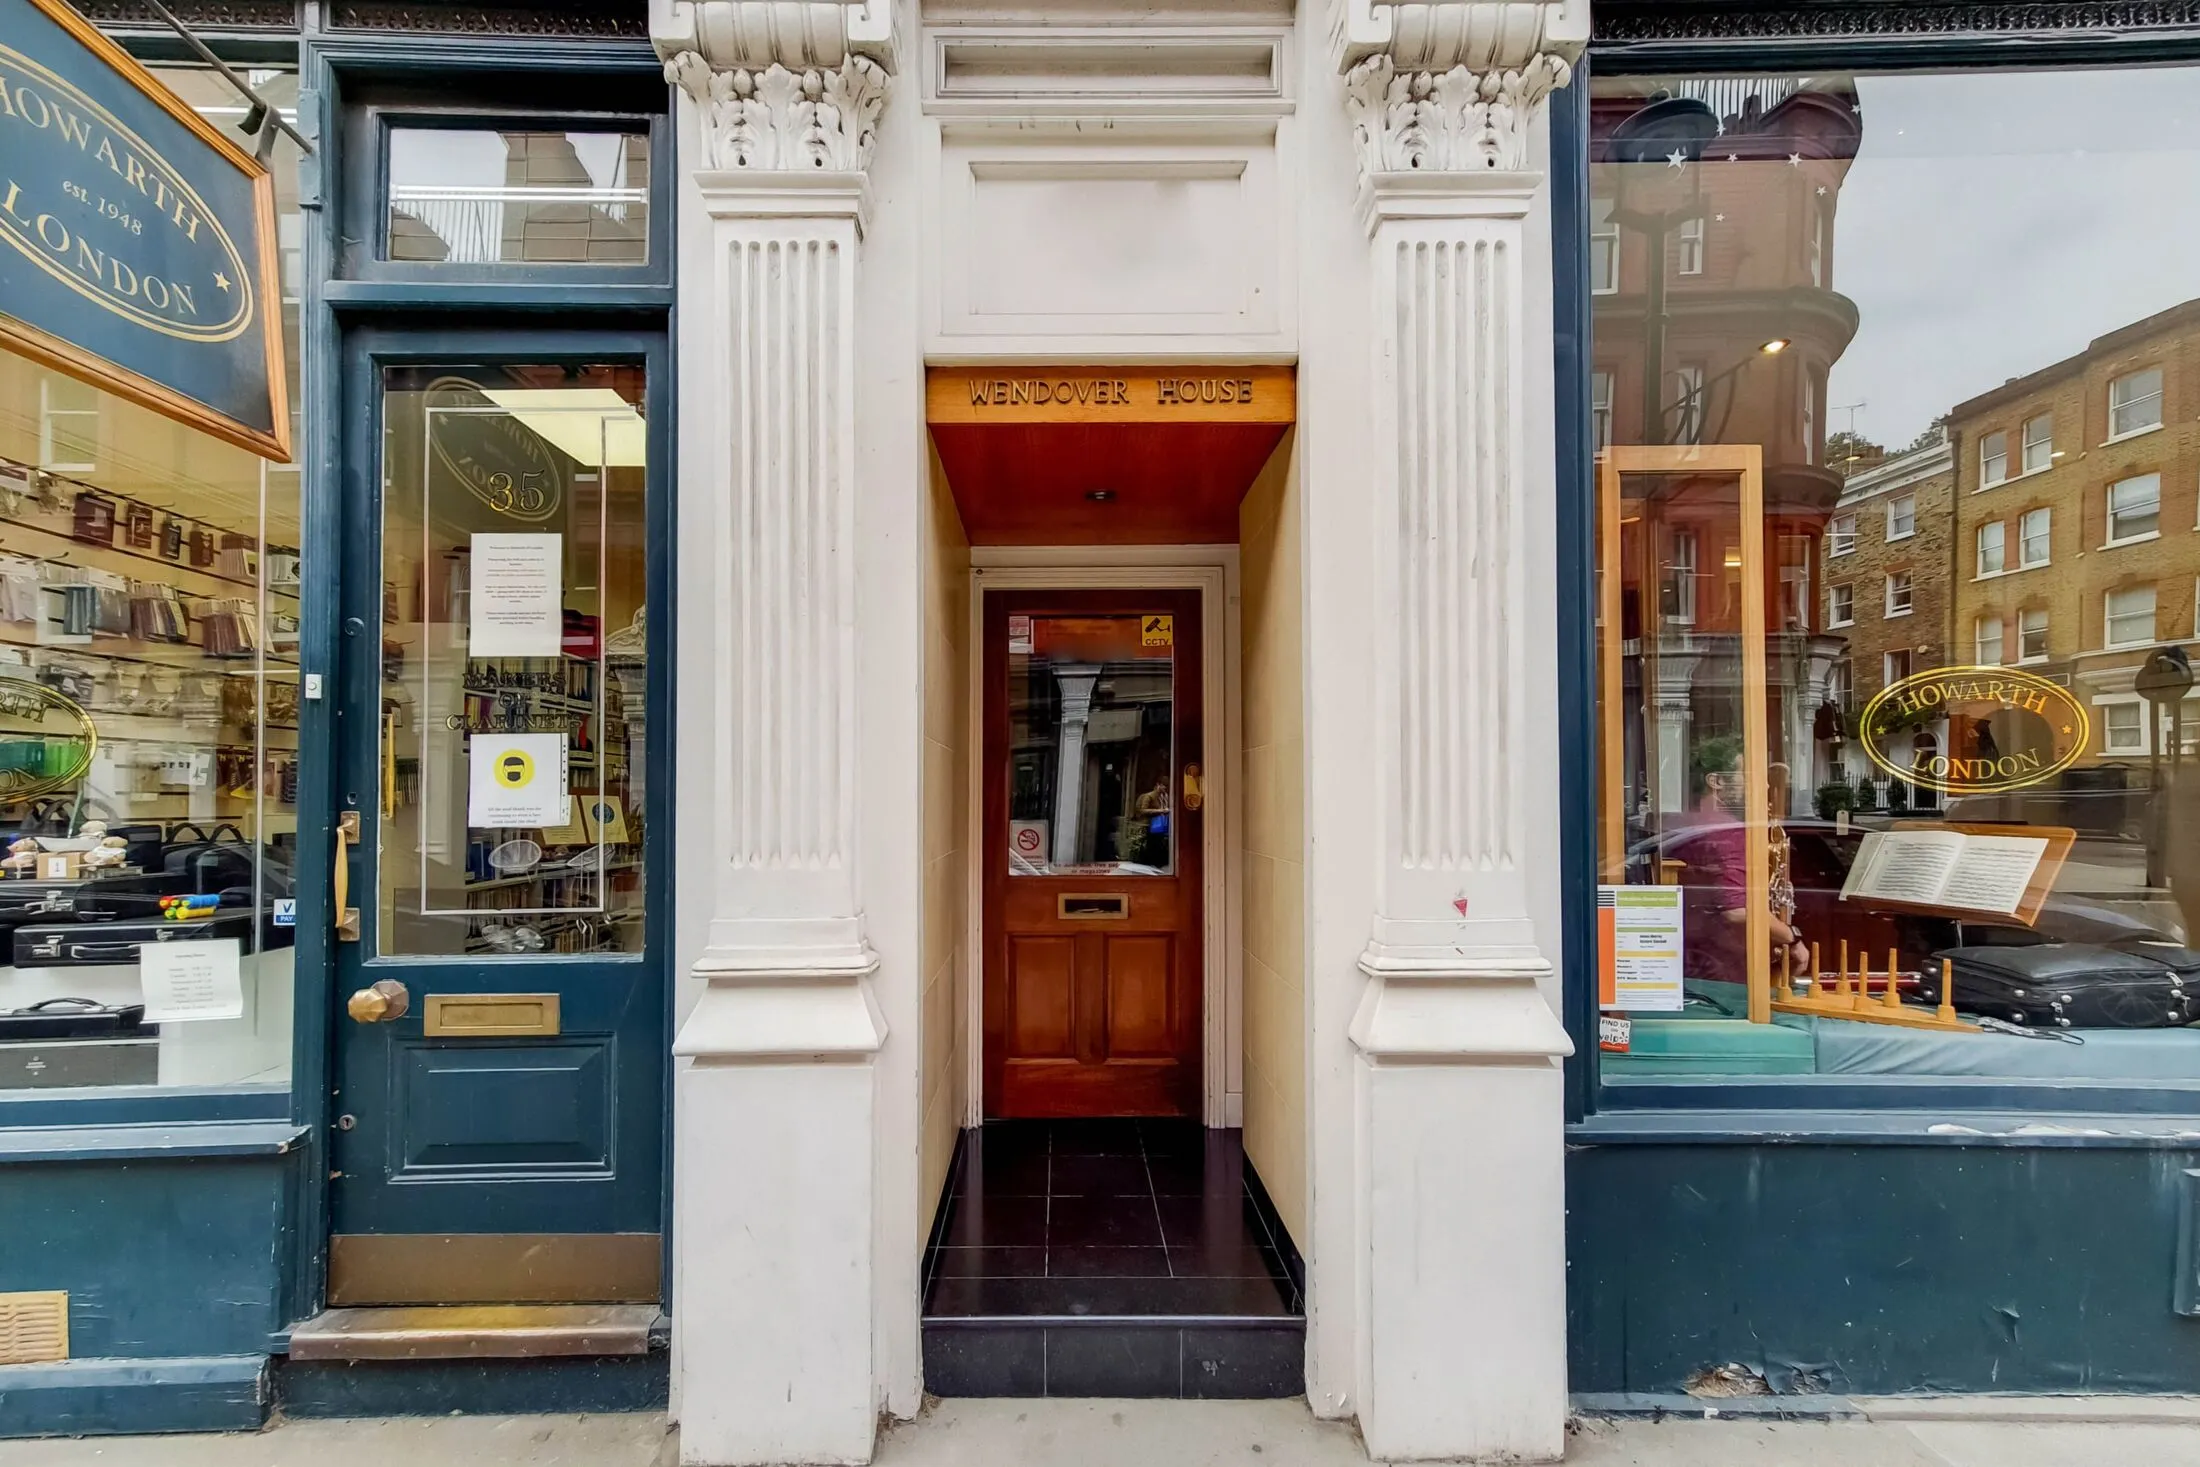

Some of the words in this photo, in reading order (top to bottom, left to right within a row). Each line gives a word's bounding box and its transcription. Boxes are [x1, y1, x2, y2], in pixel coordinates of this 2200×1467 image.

[62, 180, 92, 206] est.
[97, 197, 144, 236] 1948
[1, 177, 198, 316] LONDON
[968, 379, 1130, 405] WENDOVER
[1157, 378, 1253, 404] HOUSE
[488, 469, 545, 512] 35
[1144, 638, 1169, 646] CCTV
[462, 672, 566, 689] MAKERS
[1897, 680, 2049, 716] HOWARTH
[445, 713, 584, 730] CLARINETS
[1910, 748, 2041, 780] LONDON
[1601, 1019, 1619, 1027] FIND
[1620, 1021, 1630, 1029] US
